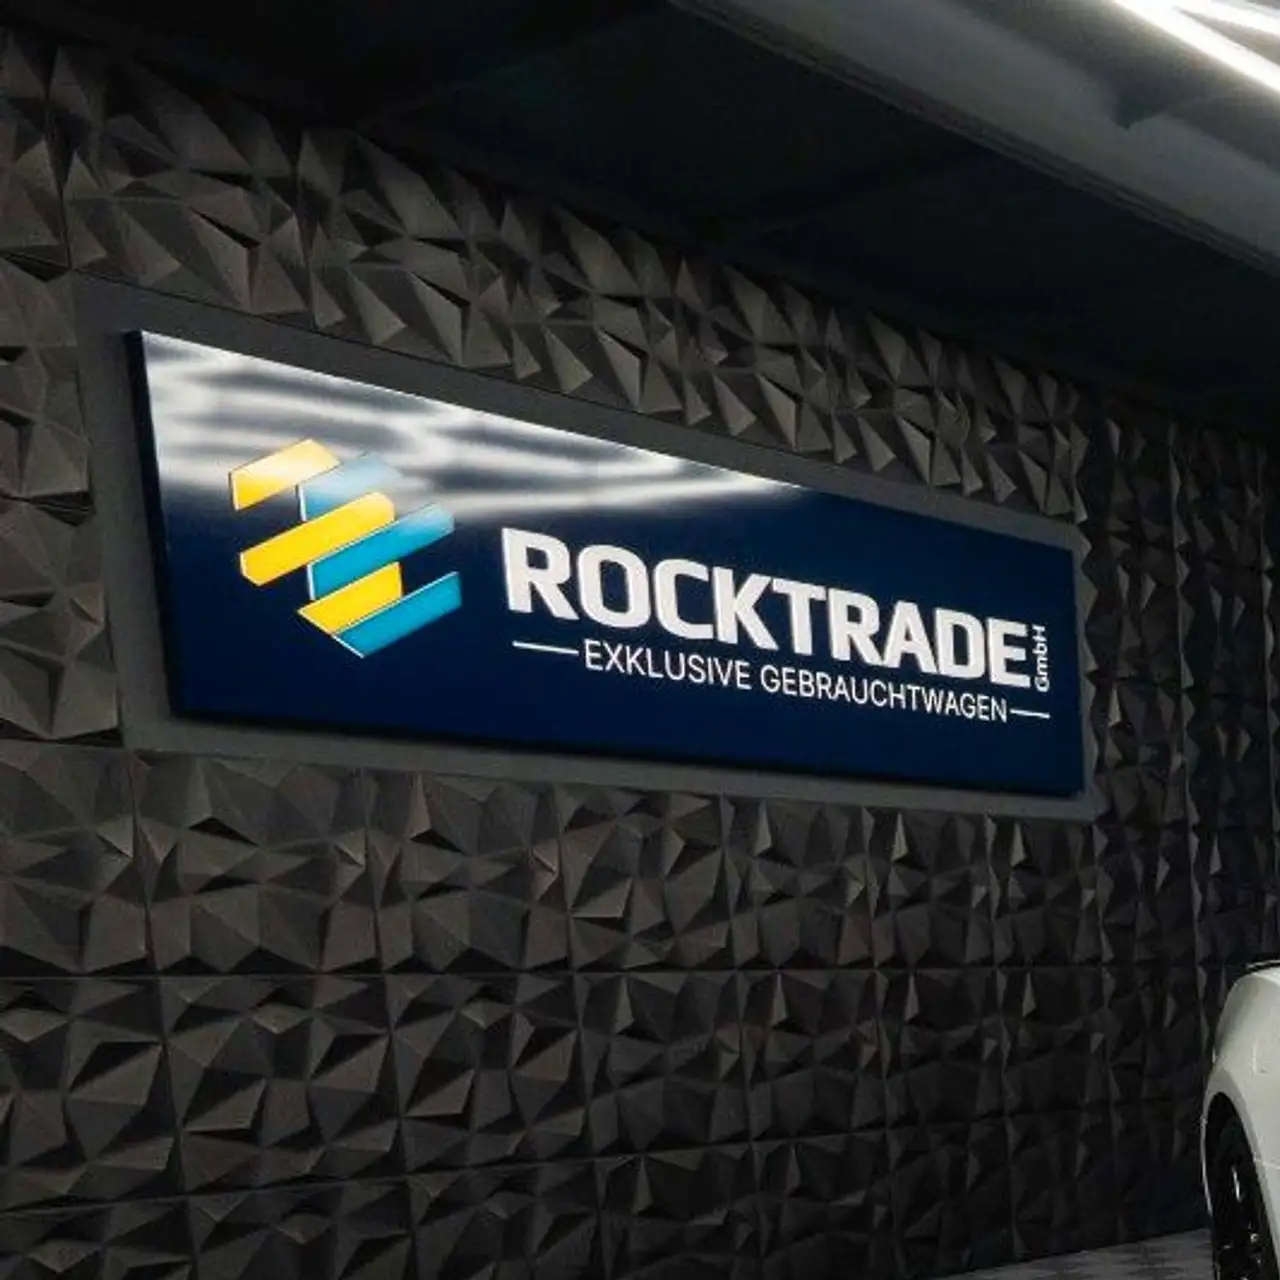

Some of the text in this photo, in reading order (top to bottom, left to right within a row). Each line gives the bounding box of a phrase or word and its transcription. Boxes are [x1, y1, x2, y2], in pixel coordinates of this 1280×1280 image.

[501, 527, 1031, 688] ROCKTRADE
[584, 638, 1007, 723] EXKLUSIVE GEBRAUCHTWAGEN
[1032, 624, 1050, 692] GmbH
